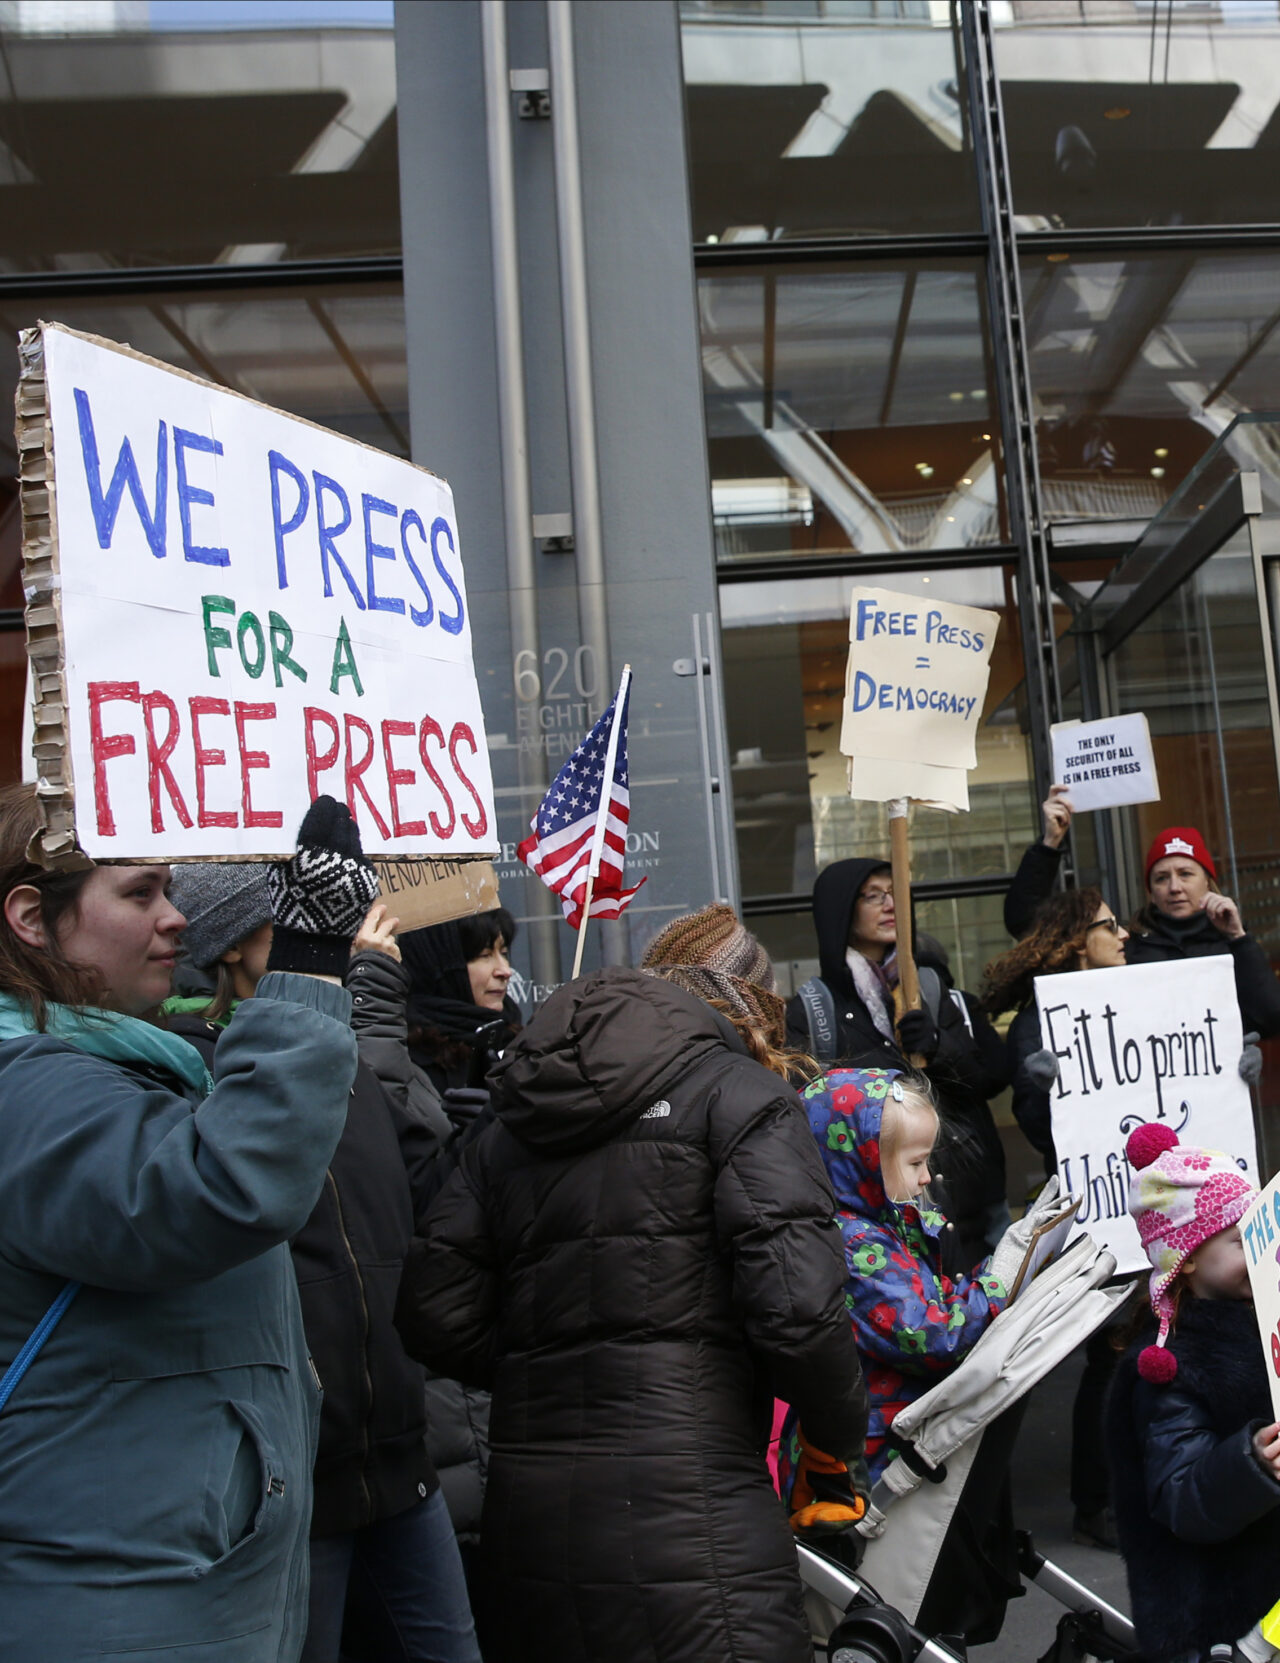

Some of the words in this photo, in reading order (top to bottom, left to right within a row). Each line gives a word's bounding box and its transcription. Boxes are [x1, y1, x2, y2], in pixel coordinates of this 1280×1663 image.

[73, 387, 231, 567] WE
[268, 450, 465, 635] PRESS
[201, 595, 307, 688] FOR
[329, 615, 365, 697] A
[856, 599, 918, 641] FREE
[925, 610, 985, 652] PRESS
[514, 644, 601, 702] 620
[853, 670, 976, 720] DEMOCRACY
[88, 680, 284, 837] FREE
[304, 706, 489, 841] PRESS
[1065, 751, 1105, 769] SECURITY
[1106, 748, 1117, 761] OF
[1119, 746, 1134, 758] ALL
[1078, 738, 1093, 751] THE
[1094, 734, 1115, 748] ONLY
[1063, 773, 1071, 785] IS
[1072, 772, 1082, 783] IN
[1083, 770, 1090, 781] A
[1090, 766, 1111, 780] FREE
[1112, 761, 1141, 776] PRESS
[1043, 1003, 1103, 1100] Fit
[1101, 1003, 1142, 1086] to
[1146, 1008, 1222, 1119] print
[1244, 1201, 1274, 1266] THE
